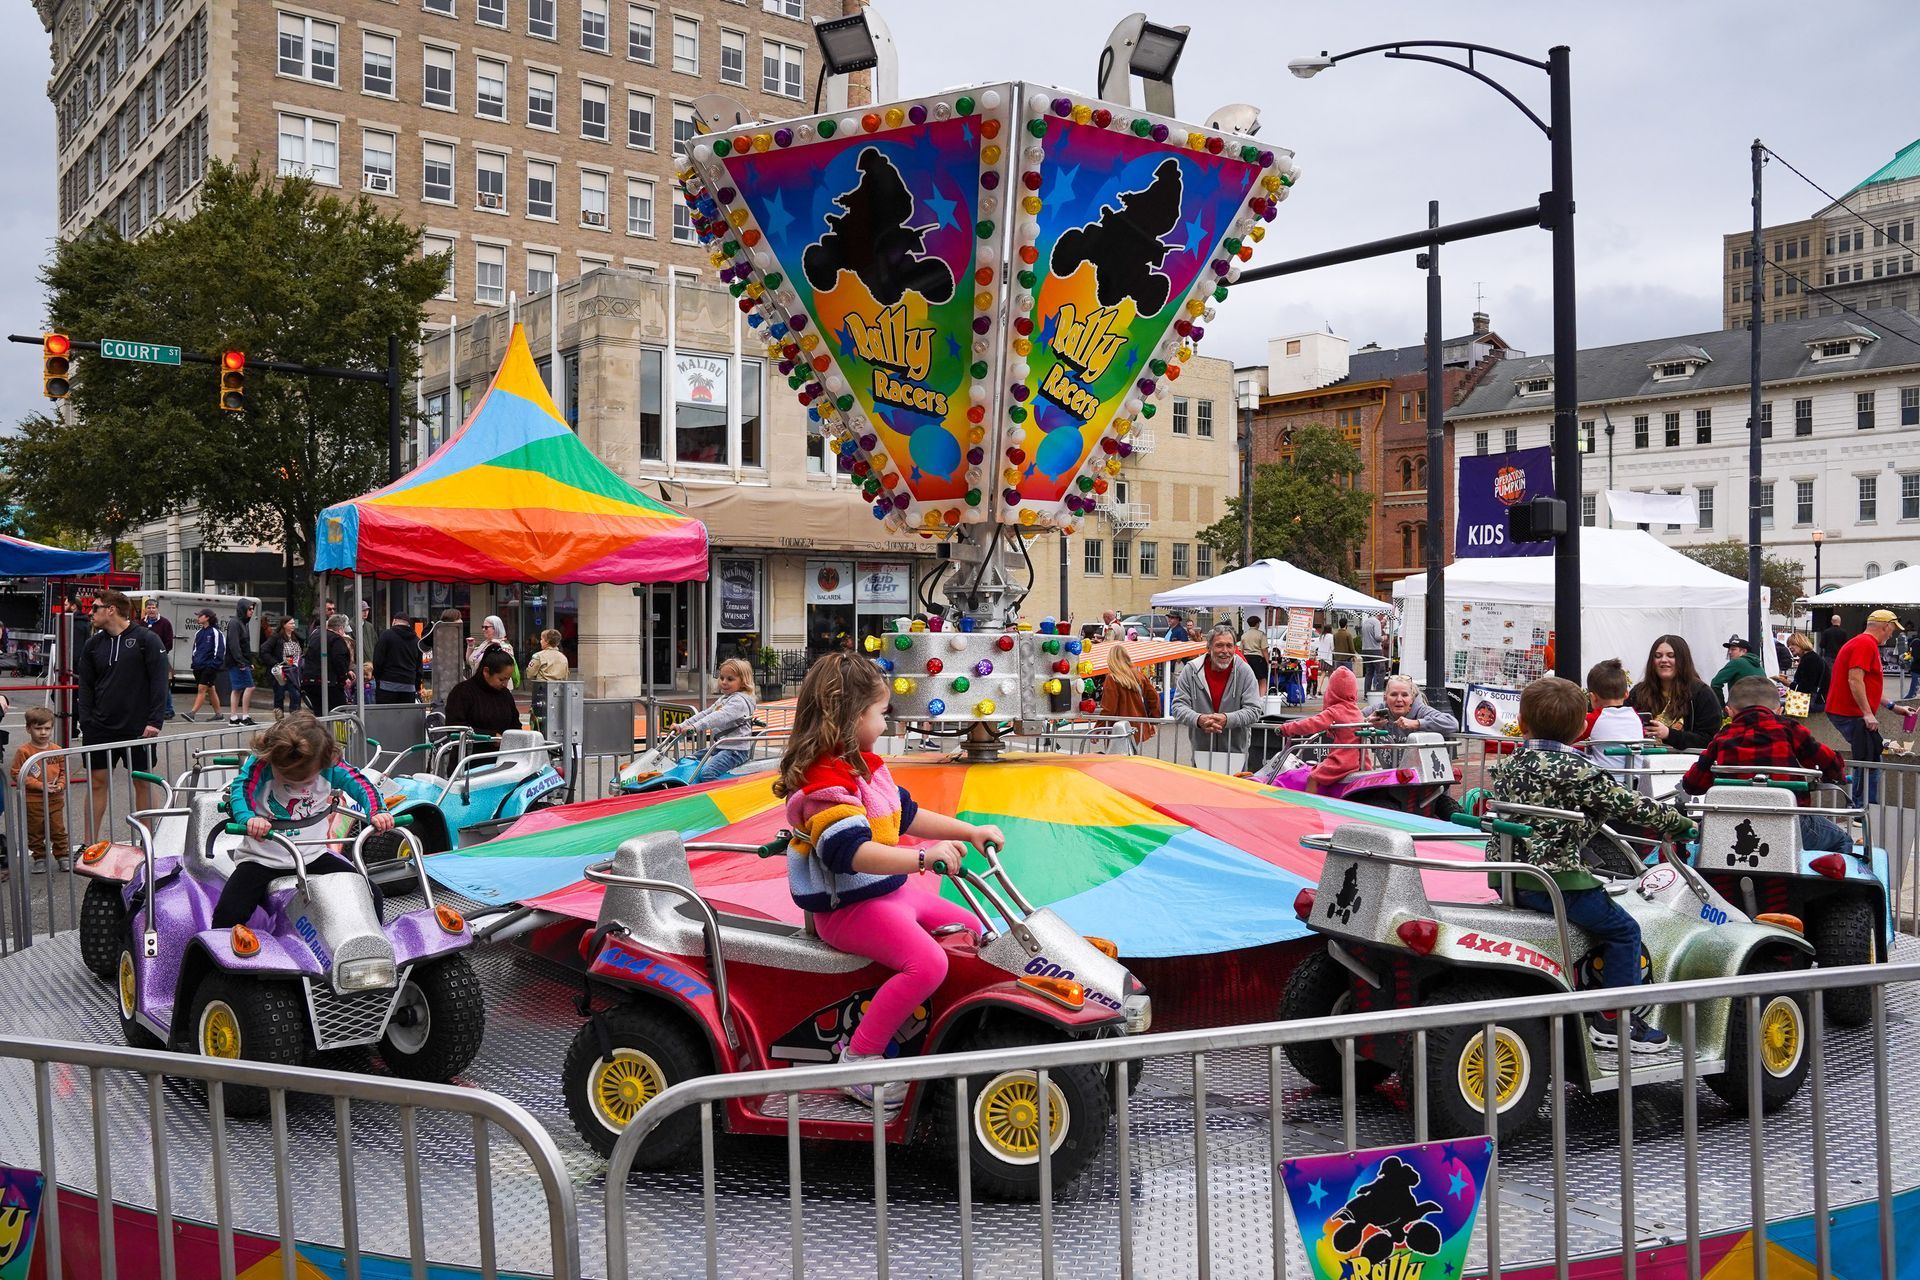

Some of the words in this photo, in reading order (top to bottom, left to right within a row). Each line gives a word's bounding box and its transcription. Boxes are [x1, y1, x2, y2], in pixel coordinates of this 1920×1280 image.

[103, 342, 160, 361] COURT
[168, 348, 179, 356] ST
[844, 305, 936, 382] Rally
[1052, 303, 1128, 384] Rally
[677, 358, 724, 378] MALIBU
[873, 370, 948, 417] Racers
[1042, 366, 1099, 421] Racers
[1494, 468, 1526, 487] OPERATION
[1494, 477, 1526, 498] PUMPKIN
[1468, 524, 1504, 545] KIDS
[864, 583, 899, 592] LIGHT
[868, 573, 894, 583] BUD
[724, 612, 751, 620] WHISKEY
[1490, 693, 1521, 702] SCOUTS
[663, 710, 691, 732] EXIT
[1700, 903, 1728, 925] 600
[295, 915, 317, 944] 600
[309, 940, 332, 971] RACER
[1456, 933, 1513, 956] 4x4
[600, 947, 655, 974] 4x4
[1346, 1252, 1425, 1280] Rally
